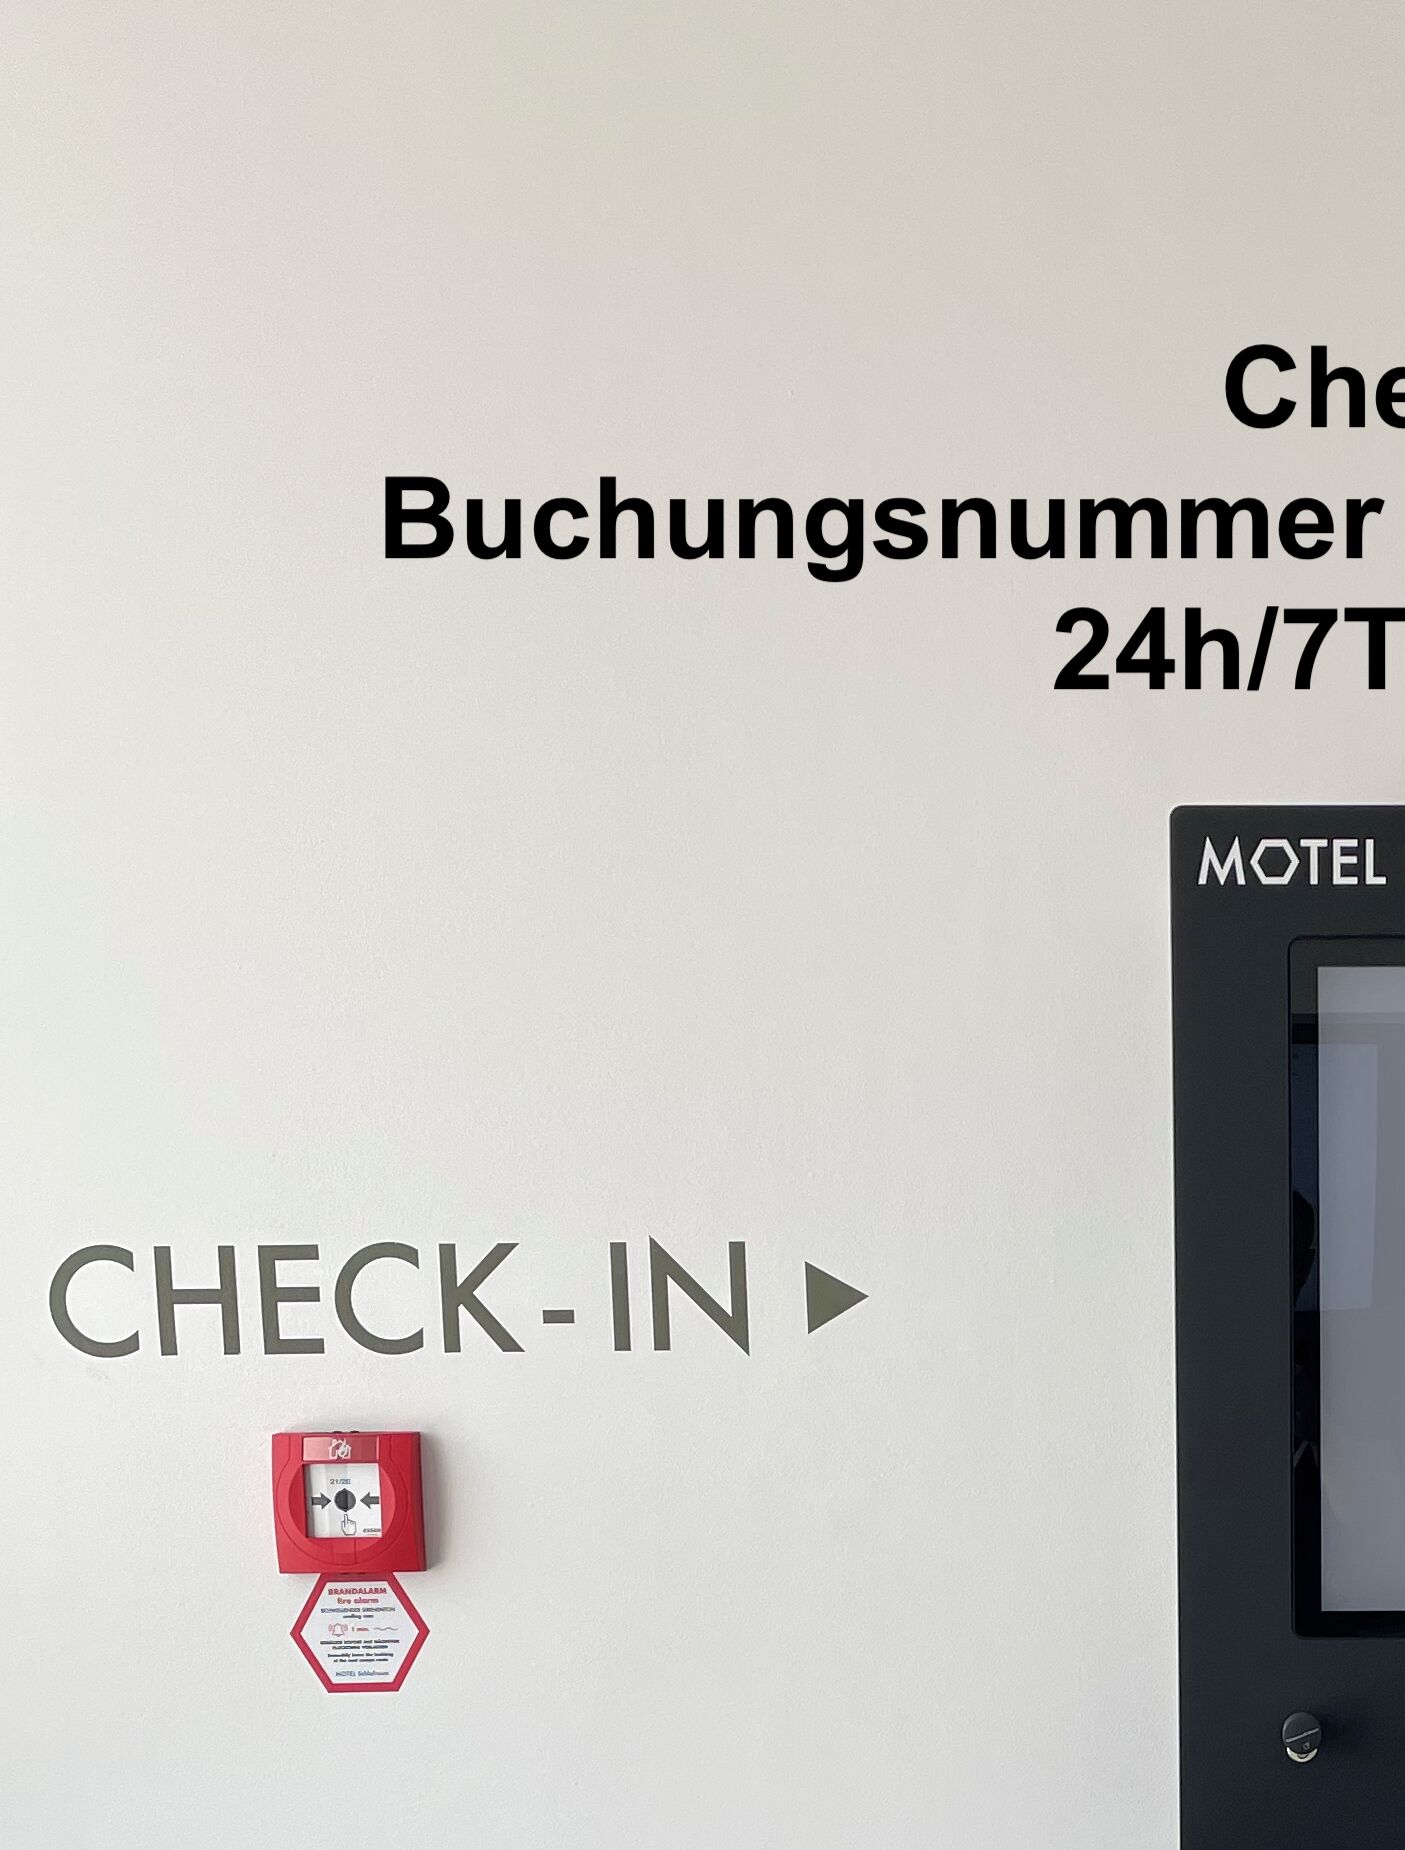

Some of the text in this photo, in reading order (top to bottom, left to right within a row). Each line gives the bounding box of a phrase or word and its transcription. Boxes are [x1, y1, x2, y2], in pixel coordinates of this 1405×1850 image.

[1198, 837, 1386, 885] MOTEL
[49, 1235, 750, 1358] CHECK-IN
[328, 1587, 387, 1595] BRANDALARM
